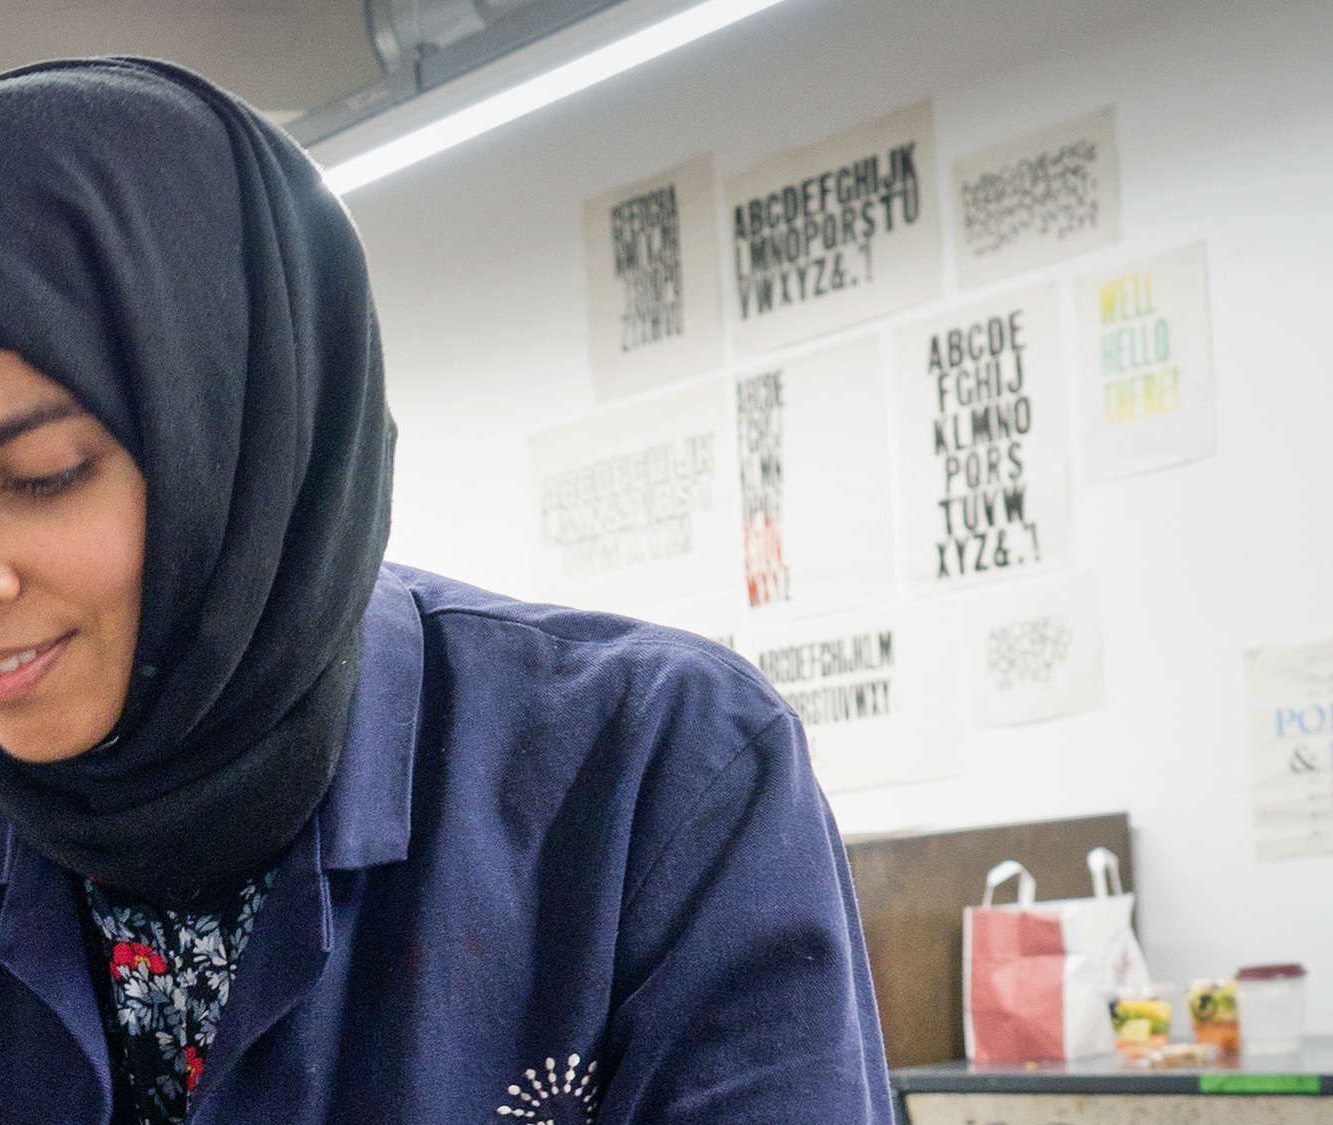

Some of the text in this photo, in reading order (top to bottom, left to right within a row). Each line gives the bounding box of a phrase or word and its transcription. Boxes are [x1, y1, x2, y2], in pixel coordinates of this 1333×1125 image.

[928, 309, 1026, 374] ABCDE
[937, 350, 1024, 413] FGHIJ
[933, 396, 1032, 455] KLMNO
[945, 441, 1024, 493] PQRS
[1276, 701, 1333, 738] PO
